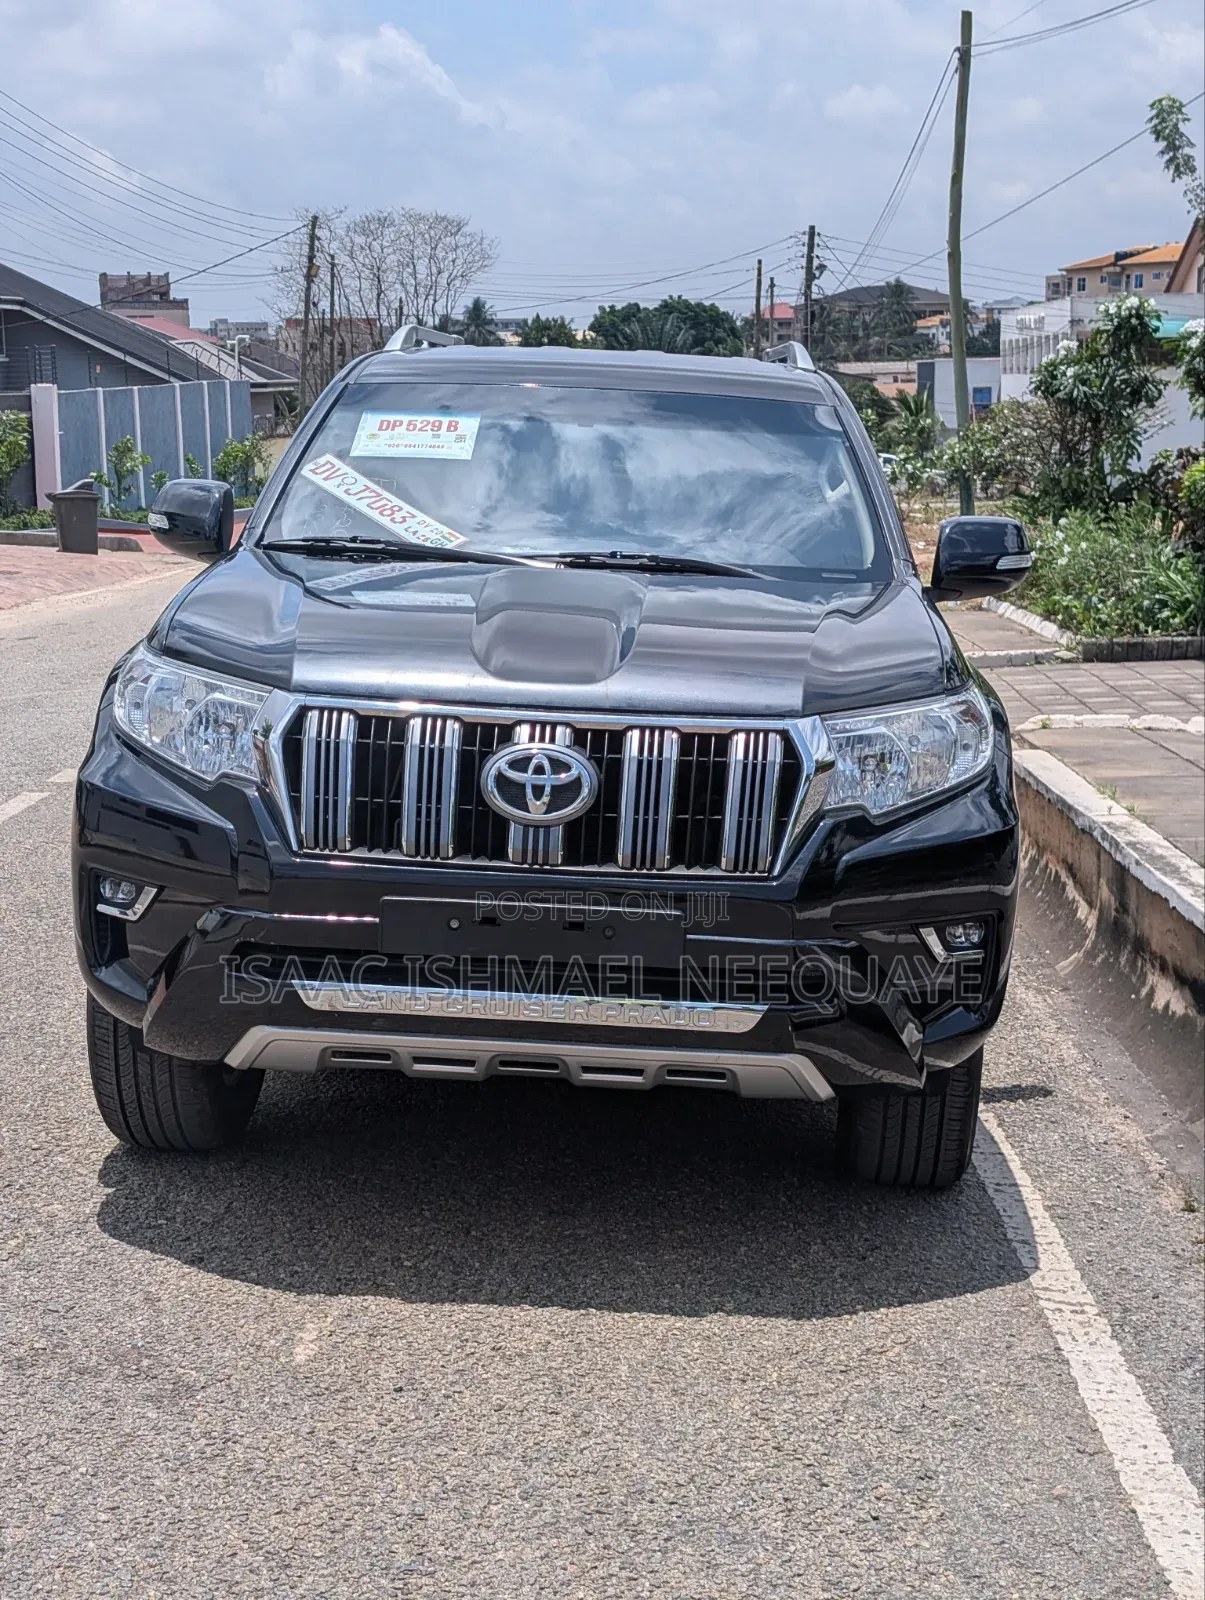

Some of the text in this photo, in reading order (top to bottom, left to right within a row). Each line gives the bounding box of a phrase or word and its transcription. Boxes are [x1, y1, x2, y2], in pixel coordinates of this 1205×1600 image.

[377, 419, 460, 433] DP 529 B
[308, 460, 349, 482] DV
[429, 538, 448, 548] GH
[342, 989, 716, 1029] LAND CRUISER PRADO
